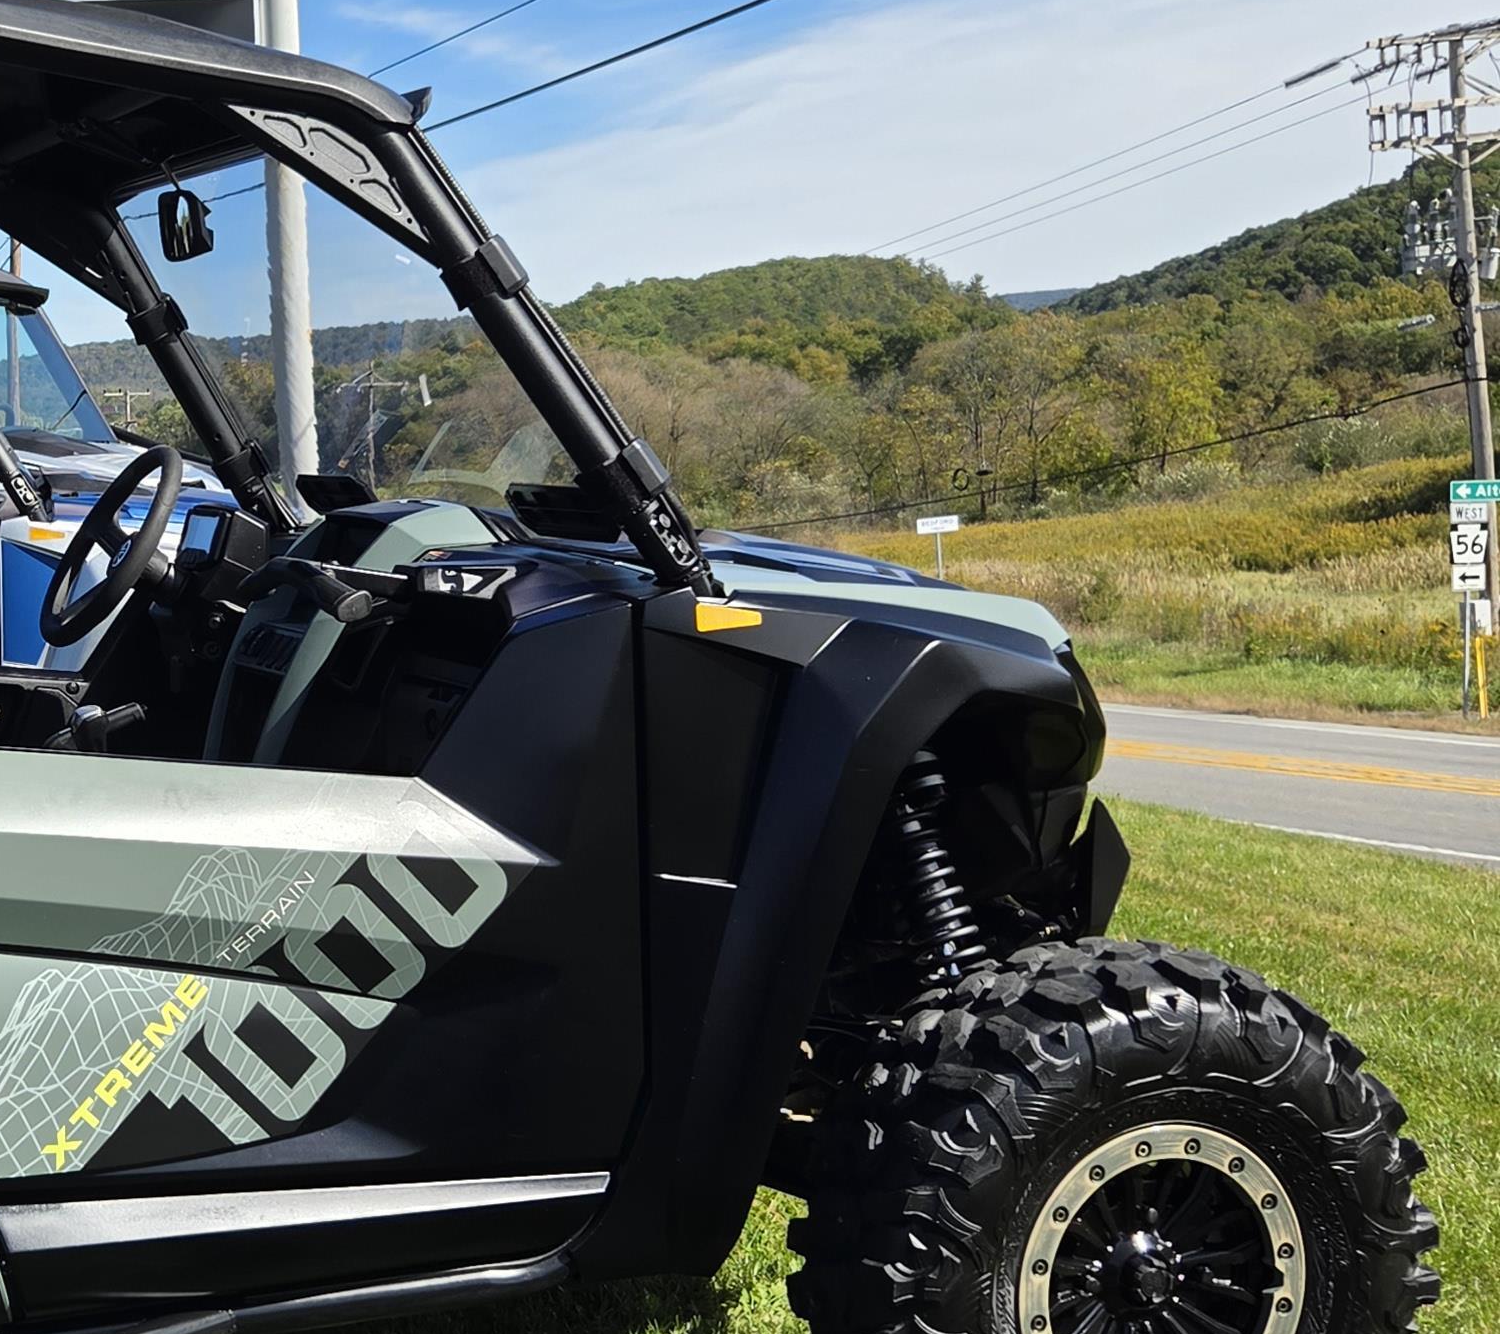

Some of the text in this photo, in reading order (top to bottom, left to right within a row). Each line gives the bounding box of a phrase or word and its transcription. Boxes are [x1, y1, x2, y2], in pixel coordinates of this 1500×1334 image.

[1475, 484, 1500, 497] Alt
[1455, 507, 1484, 519] WEST
[1456, 534, 1484, 555] 56
[150, 800, 508, 1146] 1000
[40, 870, 316, 1170] XTREME TERRAIN
